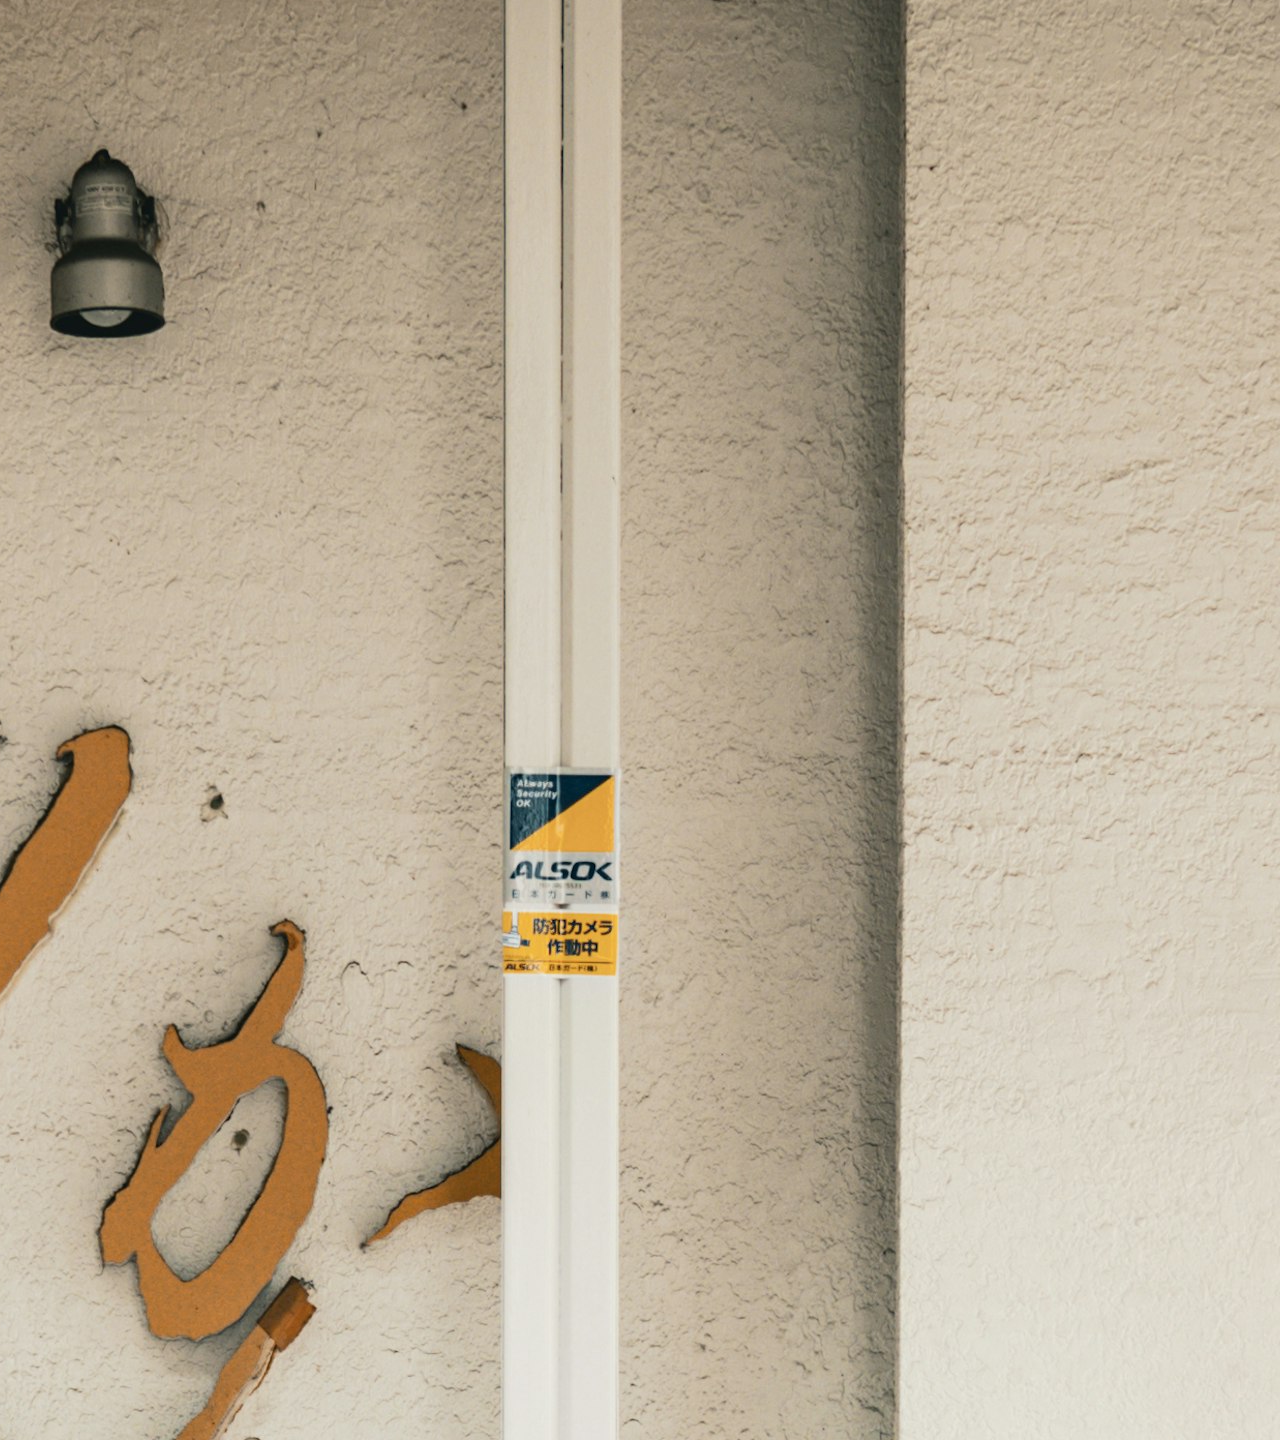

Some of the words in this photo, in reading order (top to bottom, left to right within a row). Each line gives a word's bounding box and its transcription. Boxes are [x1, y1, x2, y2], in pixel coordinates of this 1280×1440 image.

[517, 789, 558, 800] Security
[516, 799, 531, 808] OK
[510, 861, 612, 881] ALSOK
[533, 918, 613, 936] 防犯カメラ
[547, 939, 598, 956] 作動中
